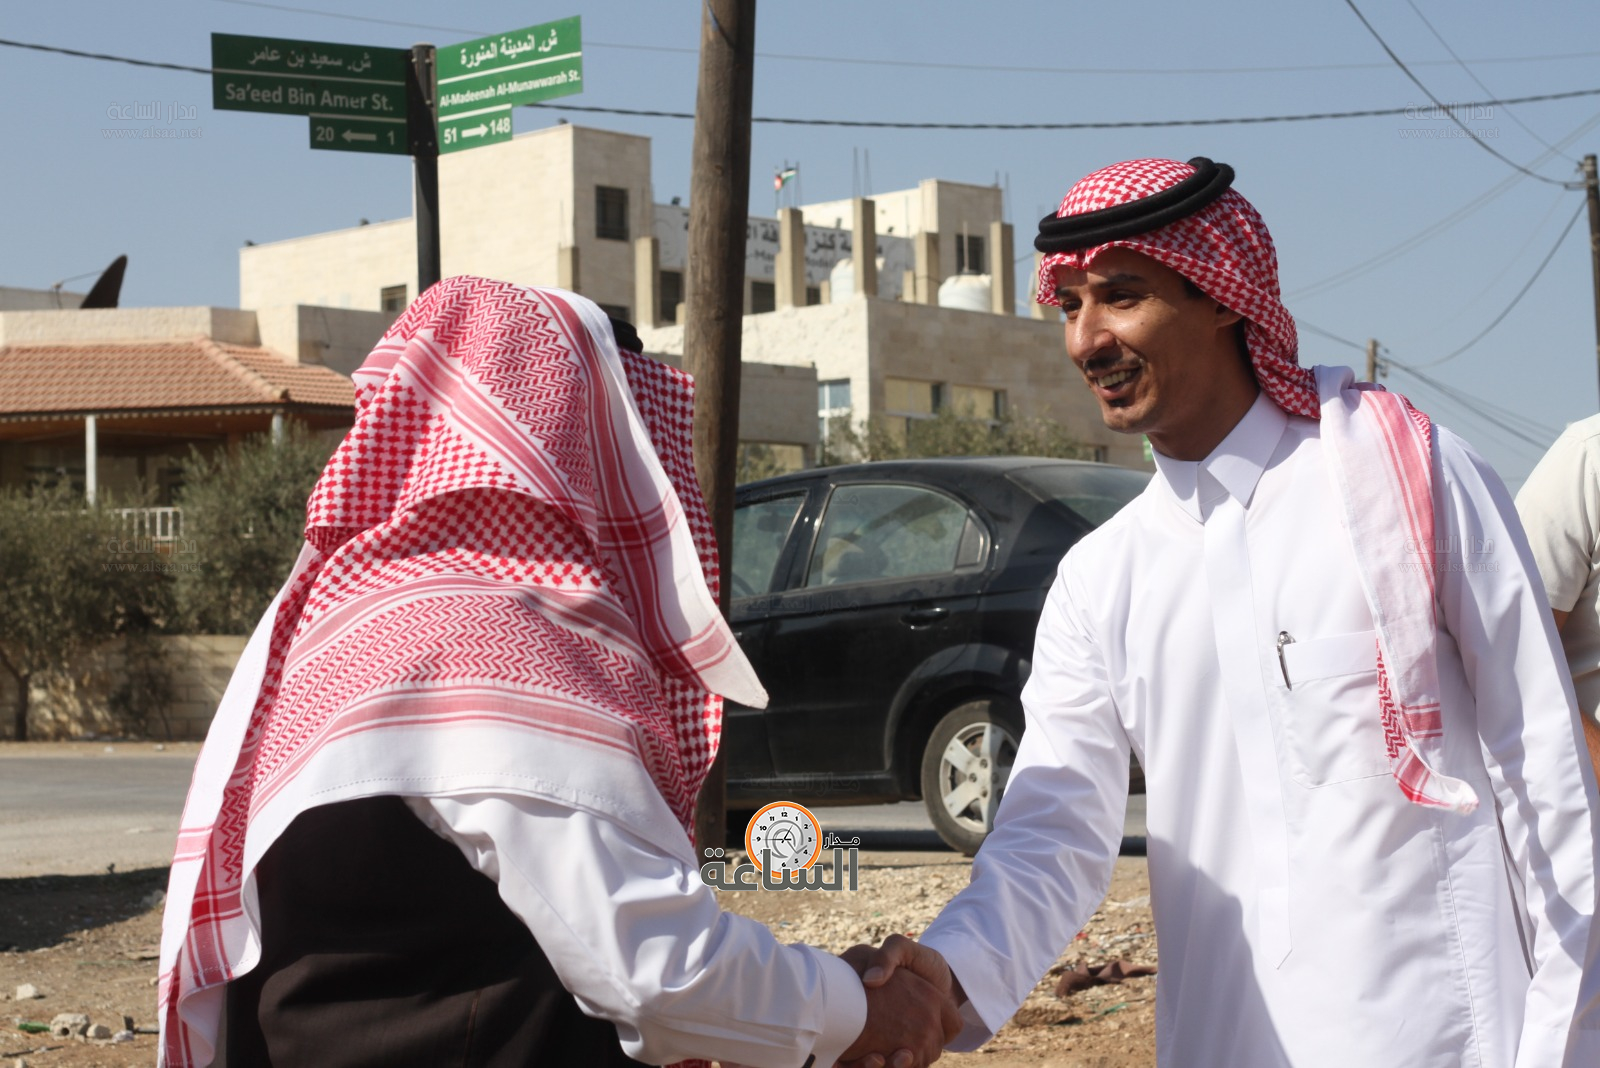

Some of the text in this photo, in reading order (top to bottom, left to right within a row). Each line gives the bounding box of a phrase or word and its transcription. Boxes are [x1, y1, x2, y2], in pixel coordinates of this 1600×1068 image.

[248, 45, 281, 66] عامر
[287, 50, 305, 68] بن
[309, 52, 343, 69] سعيد
[460, 42, 498, 68] المنورة
[288, 87, 316, 107] Bin
[320, 90, 367, 109] Amer
[371, 93, 394, 112] St.
[440, 69, 581, 108] Al-Madeenah Al-Munawwarah St.
[316, 126, 395, 146] 20 1
[443, 117, 511, 145] 51 148
